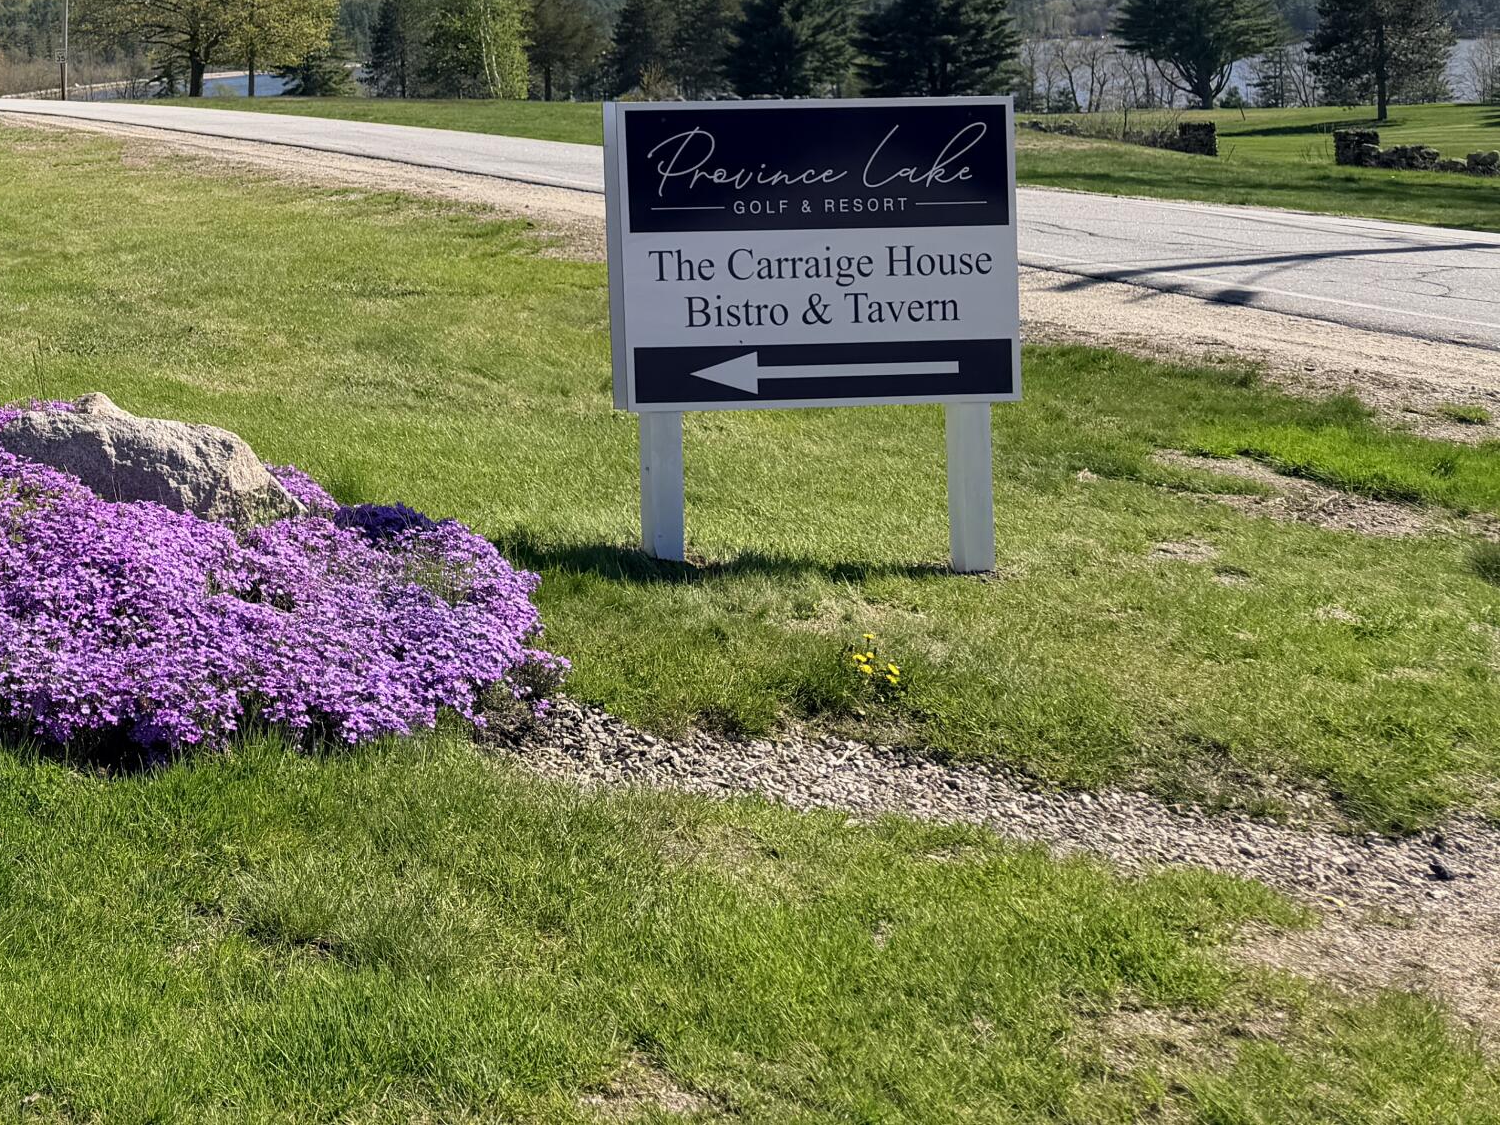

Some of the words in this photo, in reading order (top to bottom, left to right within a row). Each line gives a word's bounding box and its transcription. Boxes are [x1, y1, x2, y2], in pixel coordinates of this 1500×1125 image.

[647, 126, 848, 197] Province
[862, 122, 988, 188] Lake
[733, 200, 789, 214] GOLF
[801, 199, 812, 213] &
[824, 197, 908, 213] RESORT
[648, 249, 715, 282] The
[727, 246, 874, 287] Carraige
[885, 244, 993, 277] House
[684, 294, 789, 328] Bistro
[801, 293, 833, 324] &
[844, 292, 961, 323] Tavern
